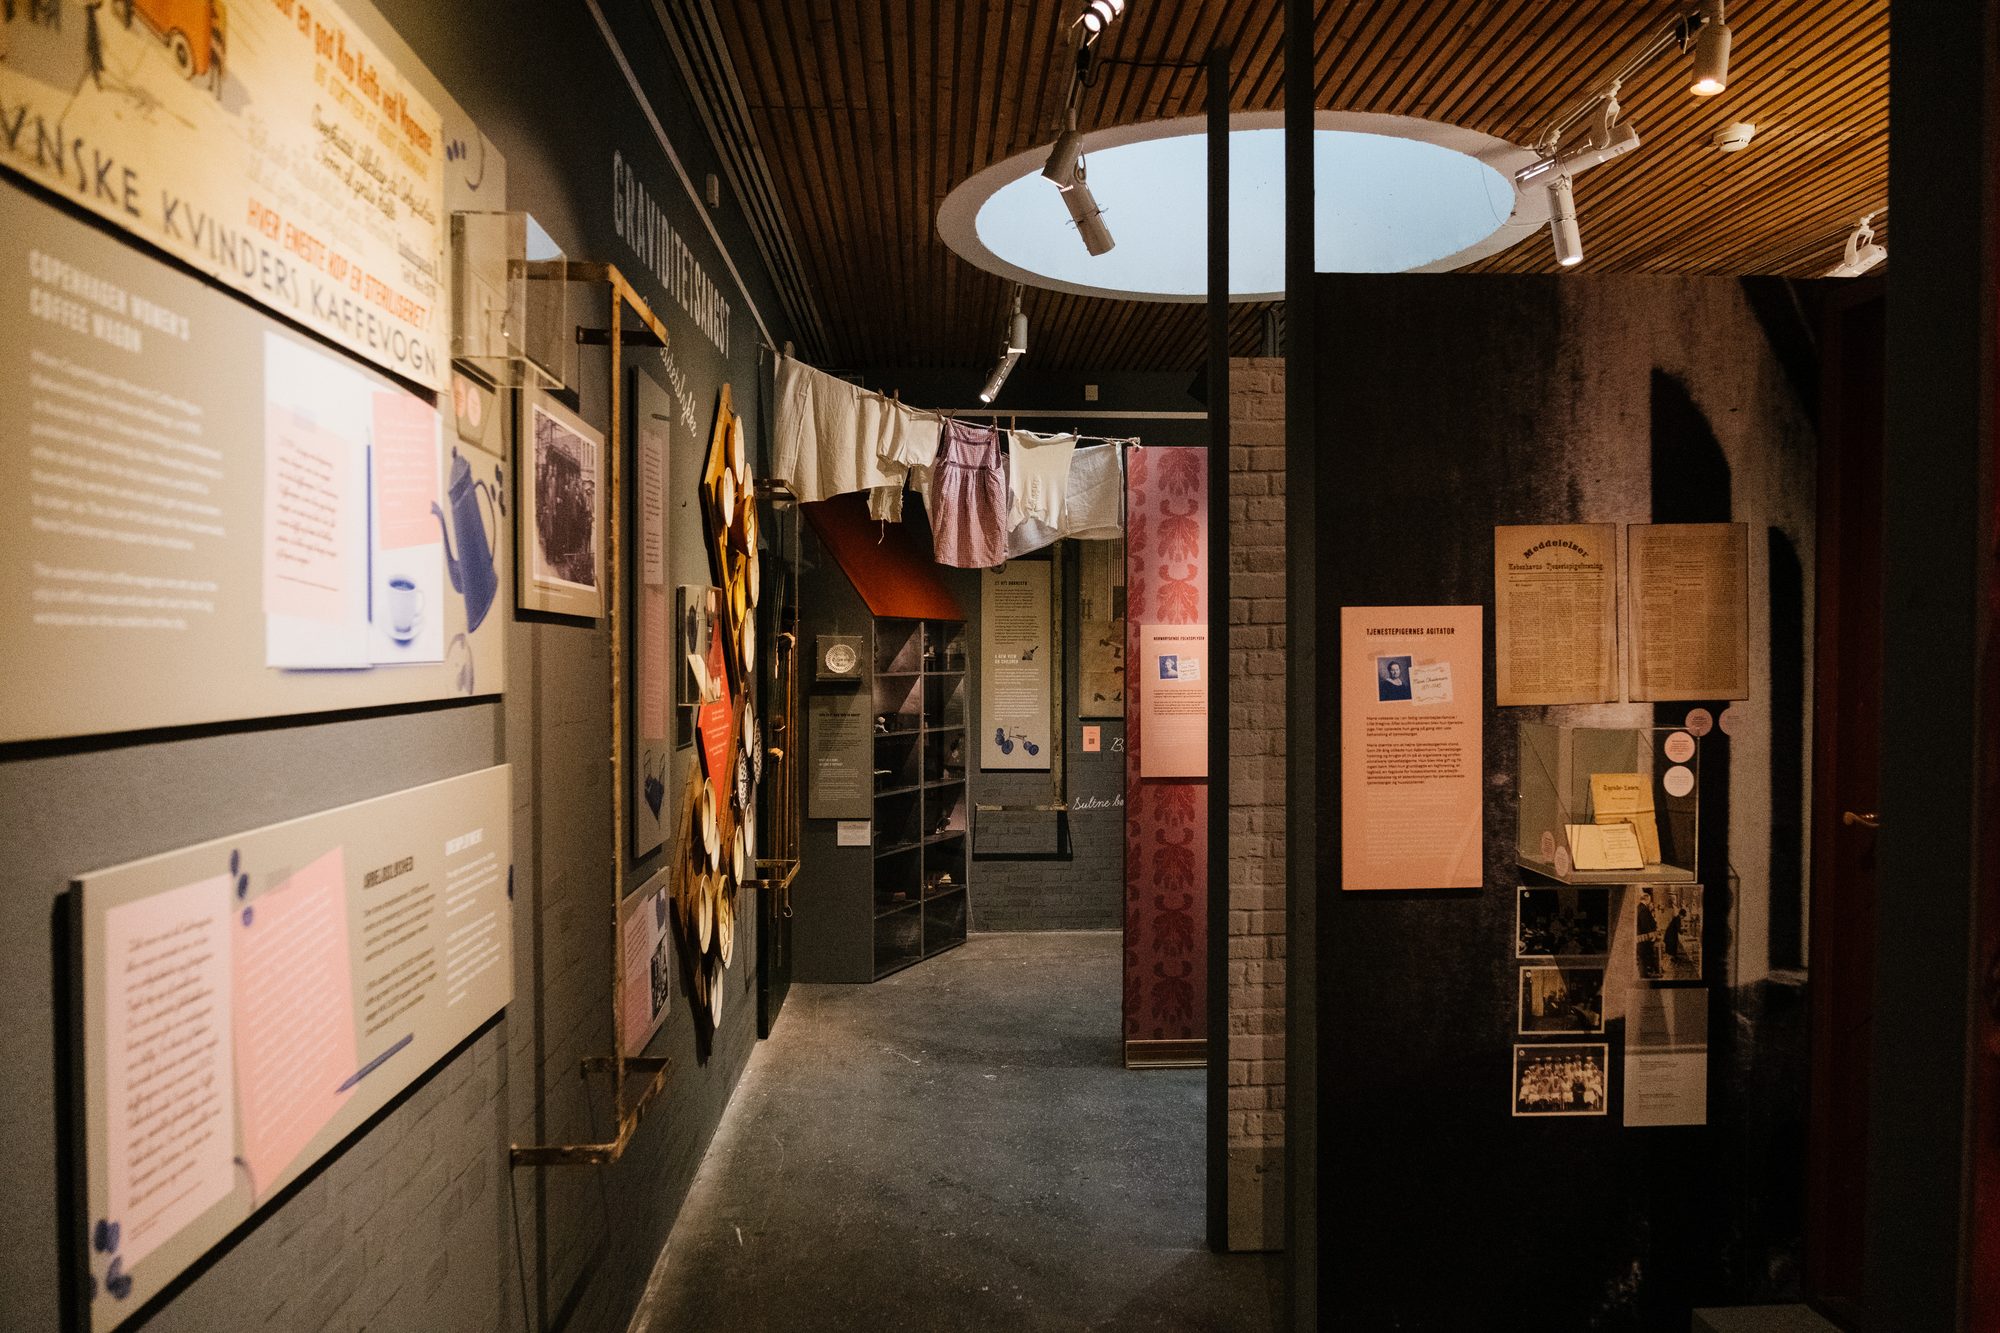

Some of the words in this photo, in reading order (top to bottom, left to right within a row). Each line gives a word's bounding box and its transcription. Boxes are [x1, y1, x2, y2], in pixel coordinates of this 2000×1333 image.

[29, 249, 129, 316] COPENHAGEN
[161, 189, 300, 309] KVINDERS
[310, 278, 436, 377] KAFFEVOGN
[613, 150, 731, 359] GRAVIDITETSANGST
[29, 286, 90, 335] COFFEE
[1523, 539, 1589, 559] Meddelelser
[1366, 628, 1424, 636] TJENESTEPIGERNES
